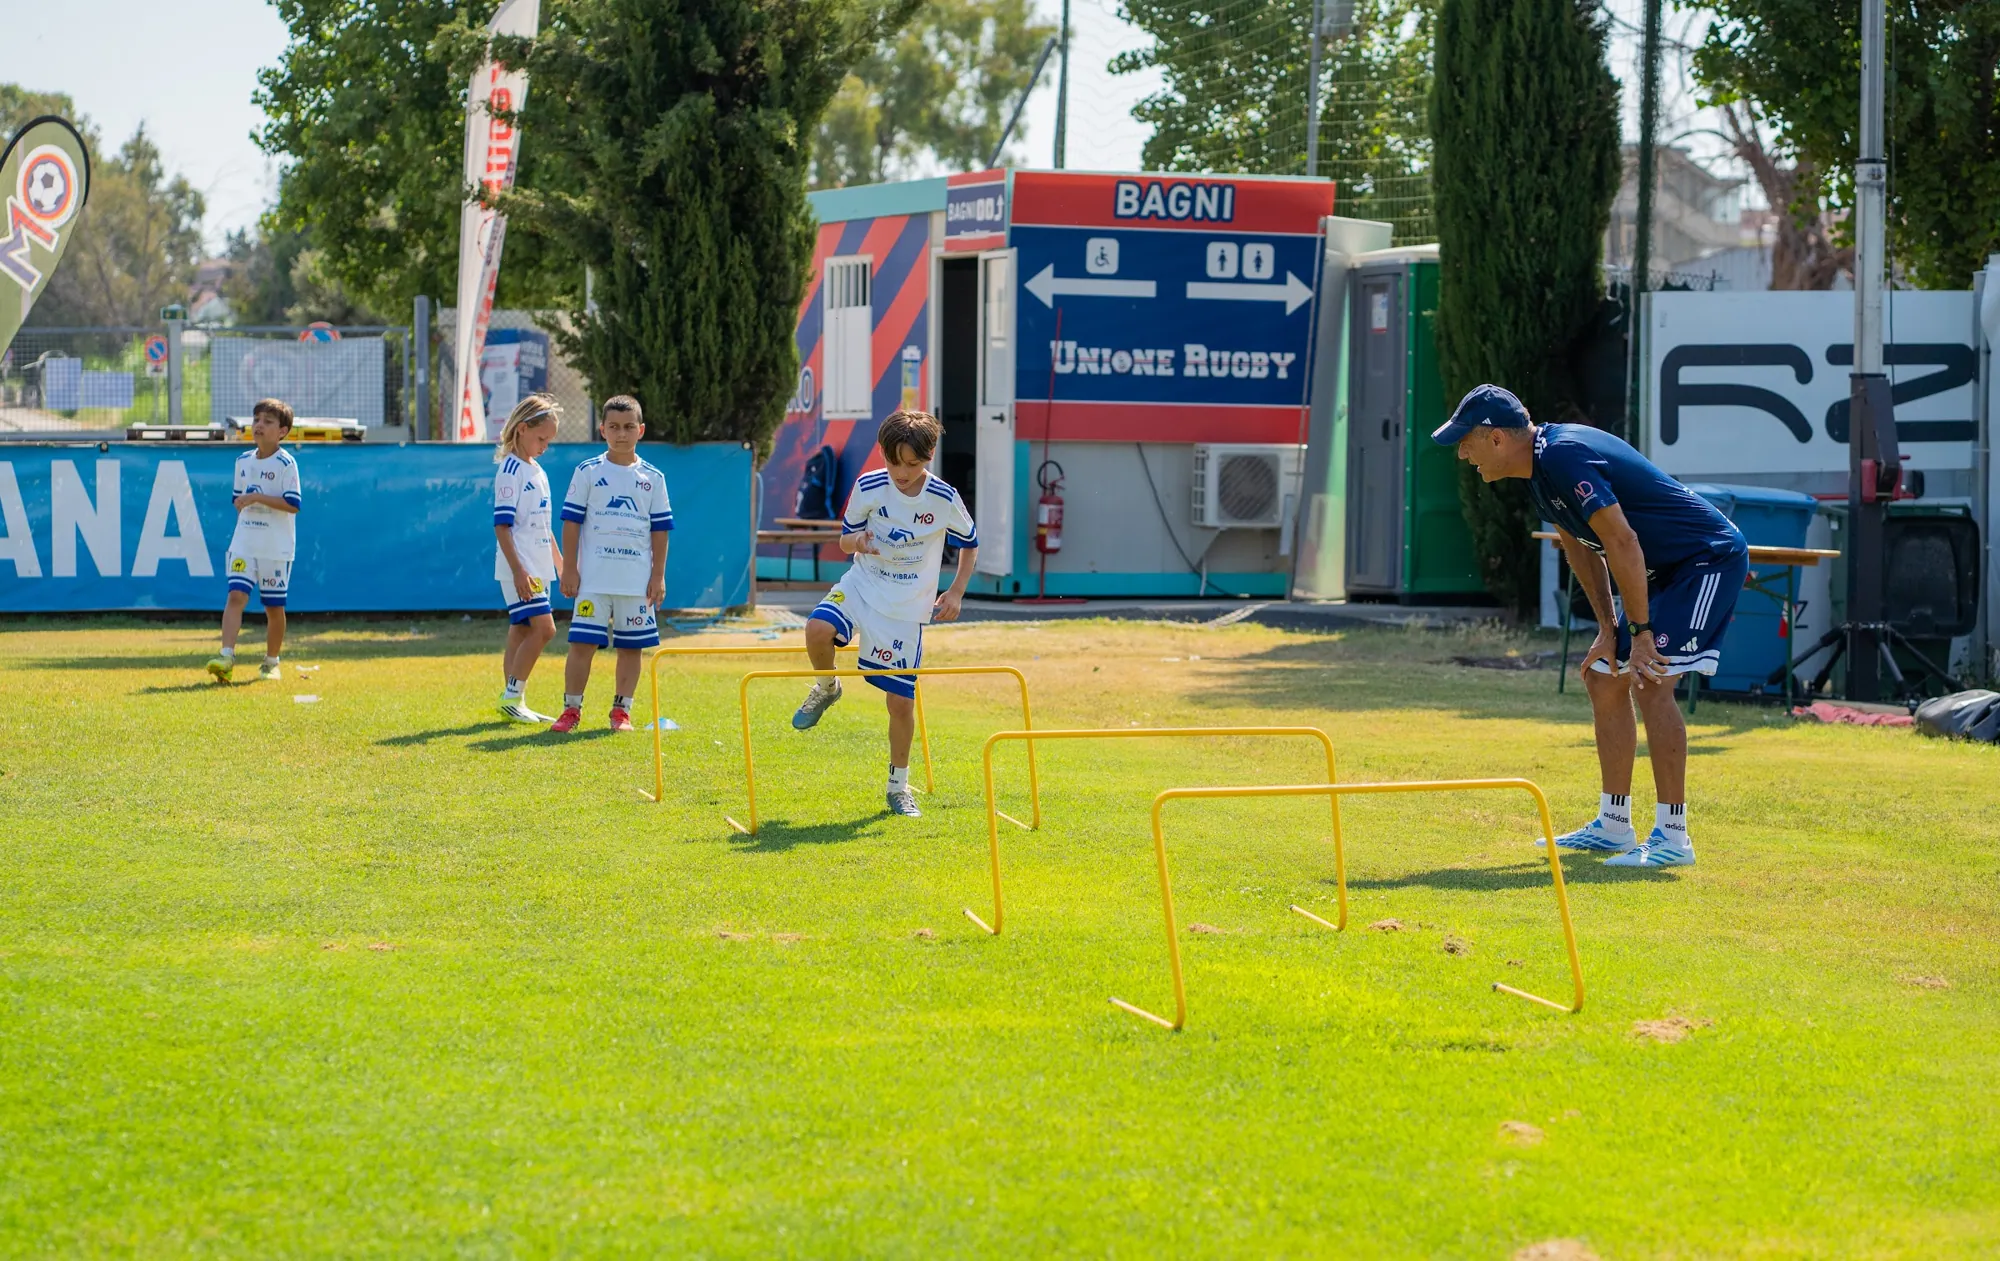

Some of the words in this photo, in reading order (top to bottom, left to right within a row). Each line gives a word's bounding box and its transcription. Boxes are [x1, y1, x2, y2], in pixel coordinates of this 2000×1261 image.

[1115, 181, 1235, 221] BAGNI
[948, 201, 976, 221] BAGNI
[1184, 344, 1296, 379] RUGBY
[880, 569, 891, 577] VAL
[892, 639, 903, 651] 84
[1603, 812, 1629, 823] adidas
